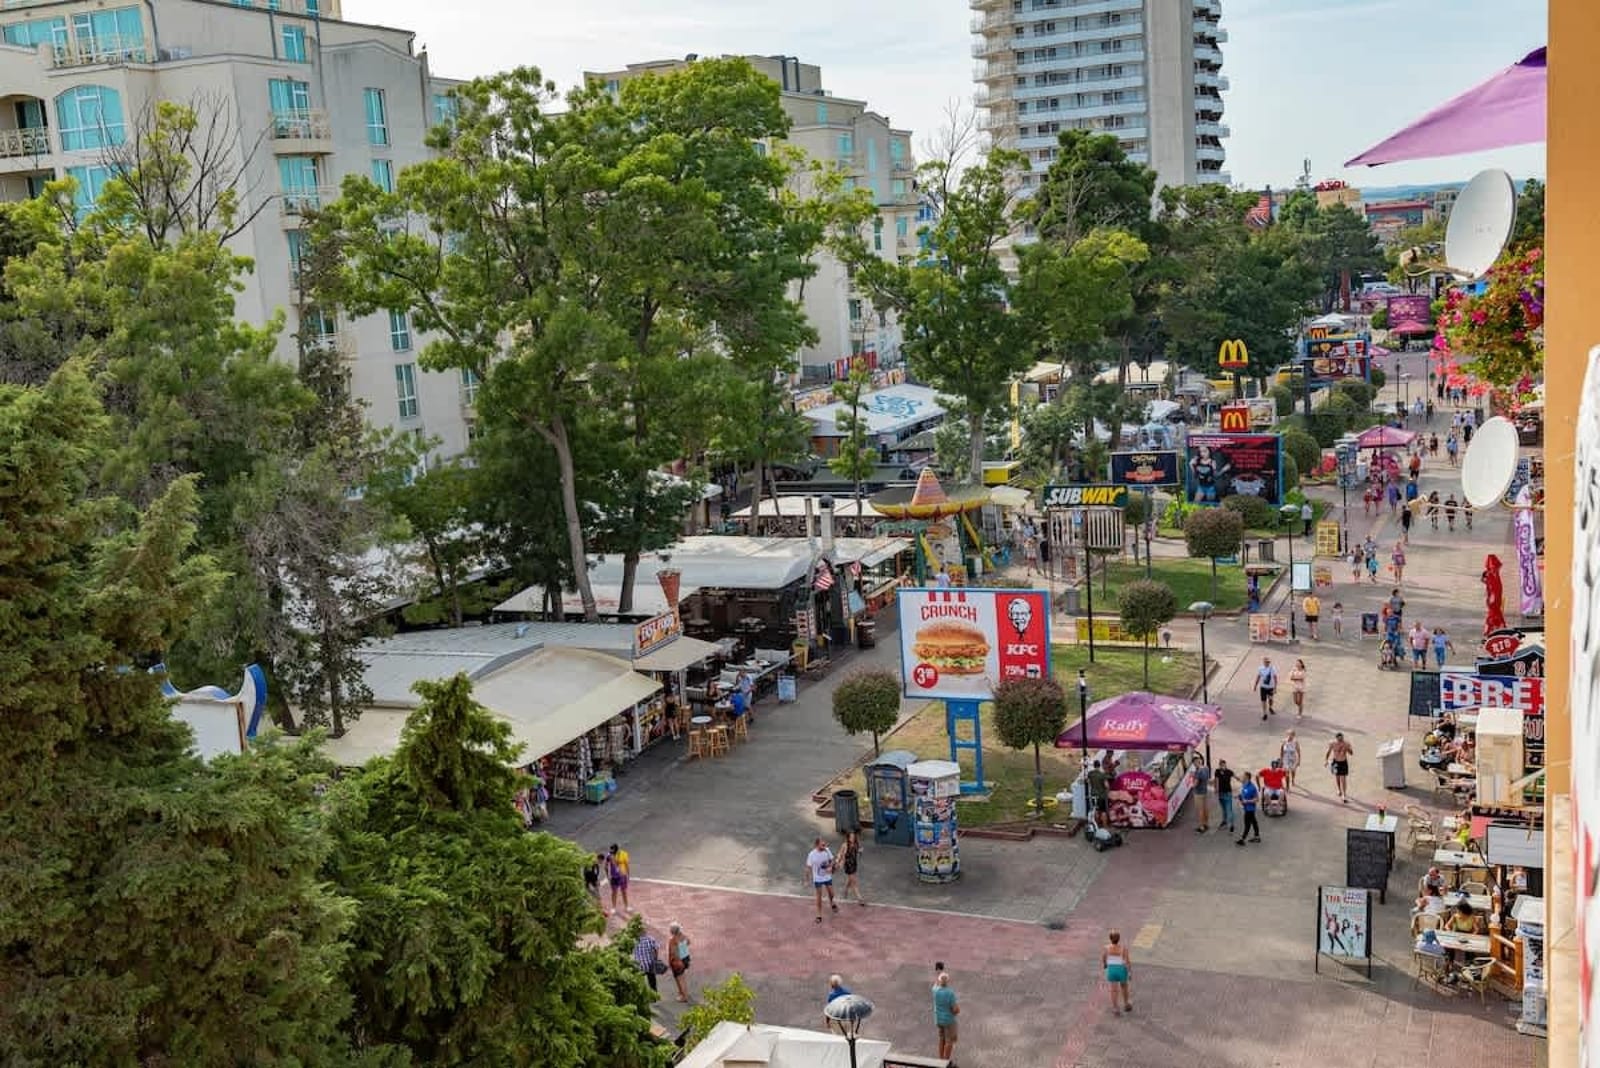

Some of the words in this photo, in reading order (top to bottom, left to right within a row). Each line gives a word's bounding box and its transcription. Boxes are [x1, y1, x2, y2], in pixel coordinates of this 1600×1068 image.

[1045, 486, 1125, 505] SUBWAY
[920, 605, 977, 622] CRUNCH
[1006, 644, 1038, 655] KFC
[1453, 679, 1544, 709] BRE
